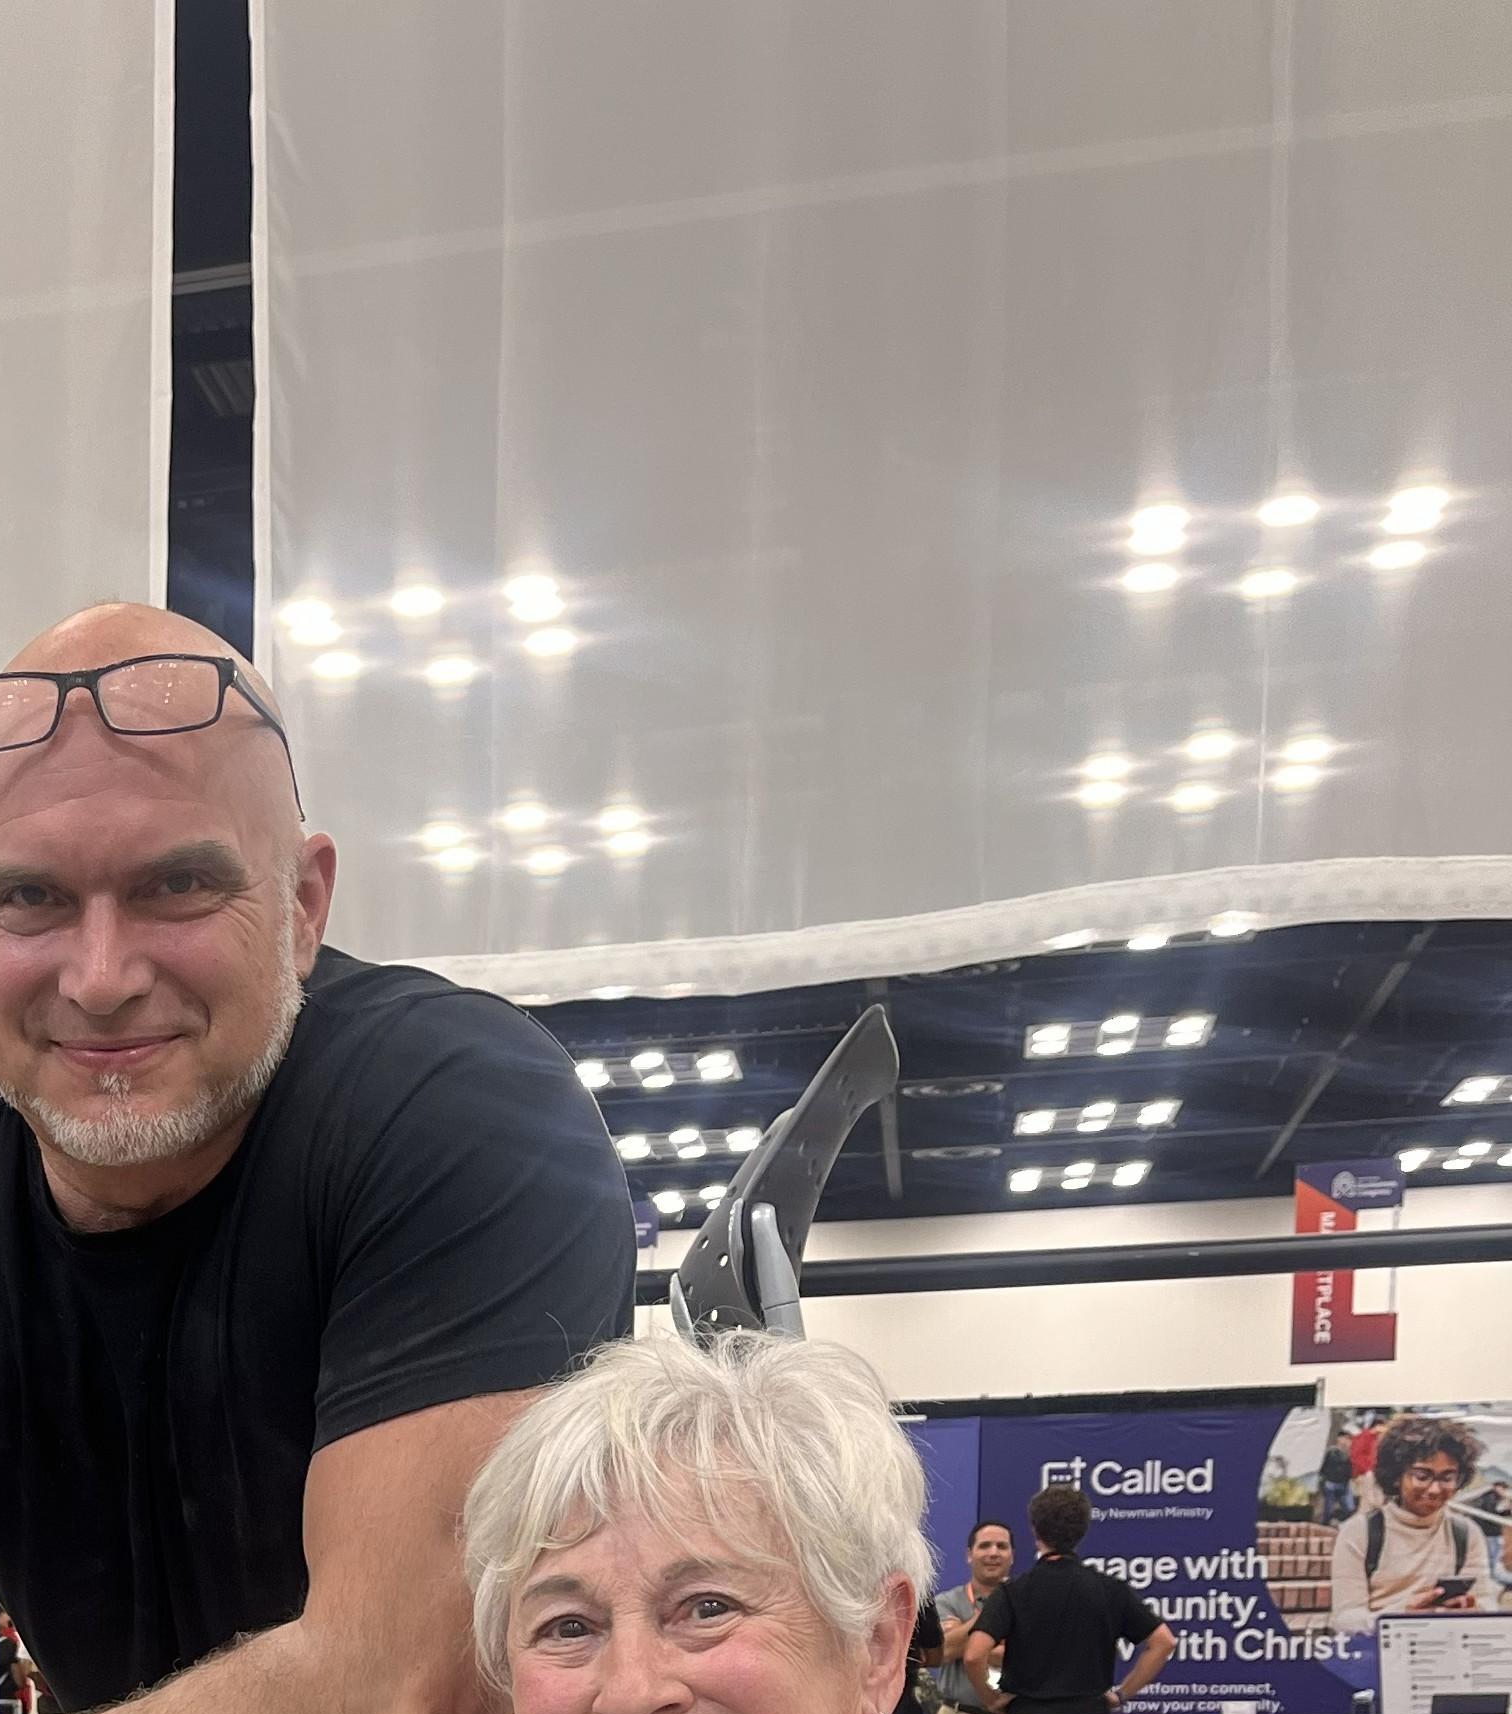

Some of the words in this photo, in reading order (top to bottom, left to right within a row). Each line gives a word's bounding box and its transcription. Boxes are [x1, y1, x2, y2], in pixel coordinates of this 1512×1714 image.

[1091, 1458, 1214, 1496] Called
[1091, 1507, 1107, 1522] By
[1109, 1507, 1163, 1519] Newman
[1165, 1506, 1214, 1521] Ministry
[1183, 1547, 1269, 1580] with
[1167, 1628, 1227, 1661] ith
[1234, 1627, 1363, 1661] Christ.
[1138, 1682, 1188, 1695] atform
[1191, 1683, 1207, 1695] to
[1210, 1682, 1276, 1697] connect,
[1161, 1700, 1194, 1714] your
